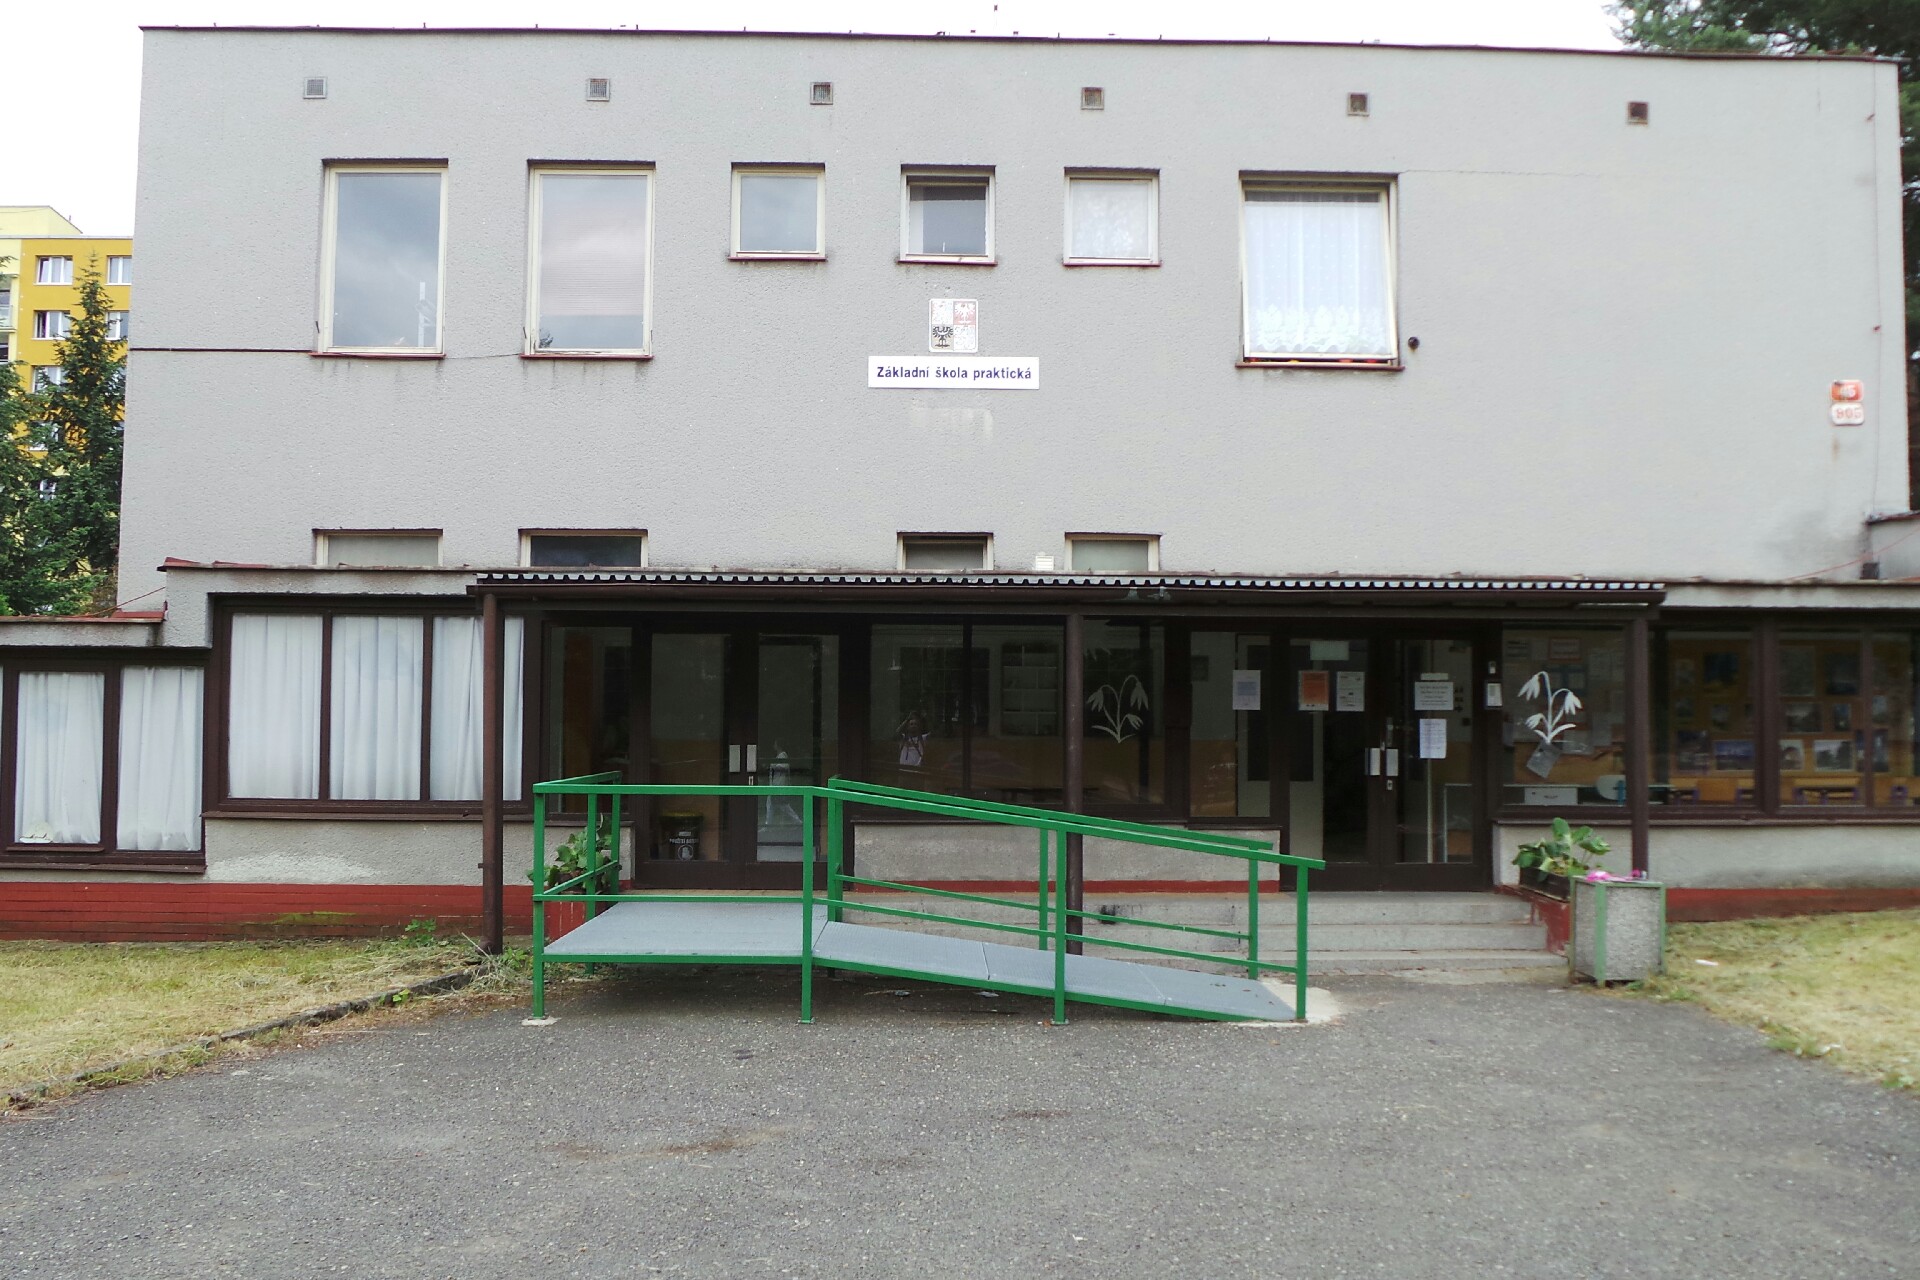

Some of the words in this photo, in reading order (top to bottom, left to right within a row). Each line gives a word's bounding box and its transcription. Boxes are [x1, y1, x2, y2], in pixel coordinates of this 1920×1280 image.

[877, 366, 930, 378] Základní
[935, 366, 968, 379] škola
[973, 367, 1032, 381] praktická
